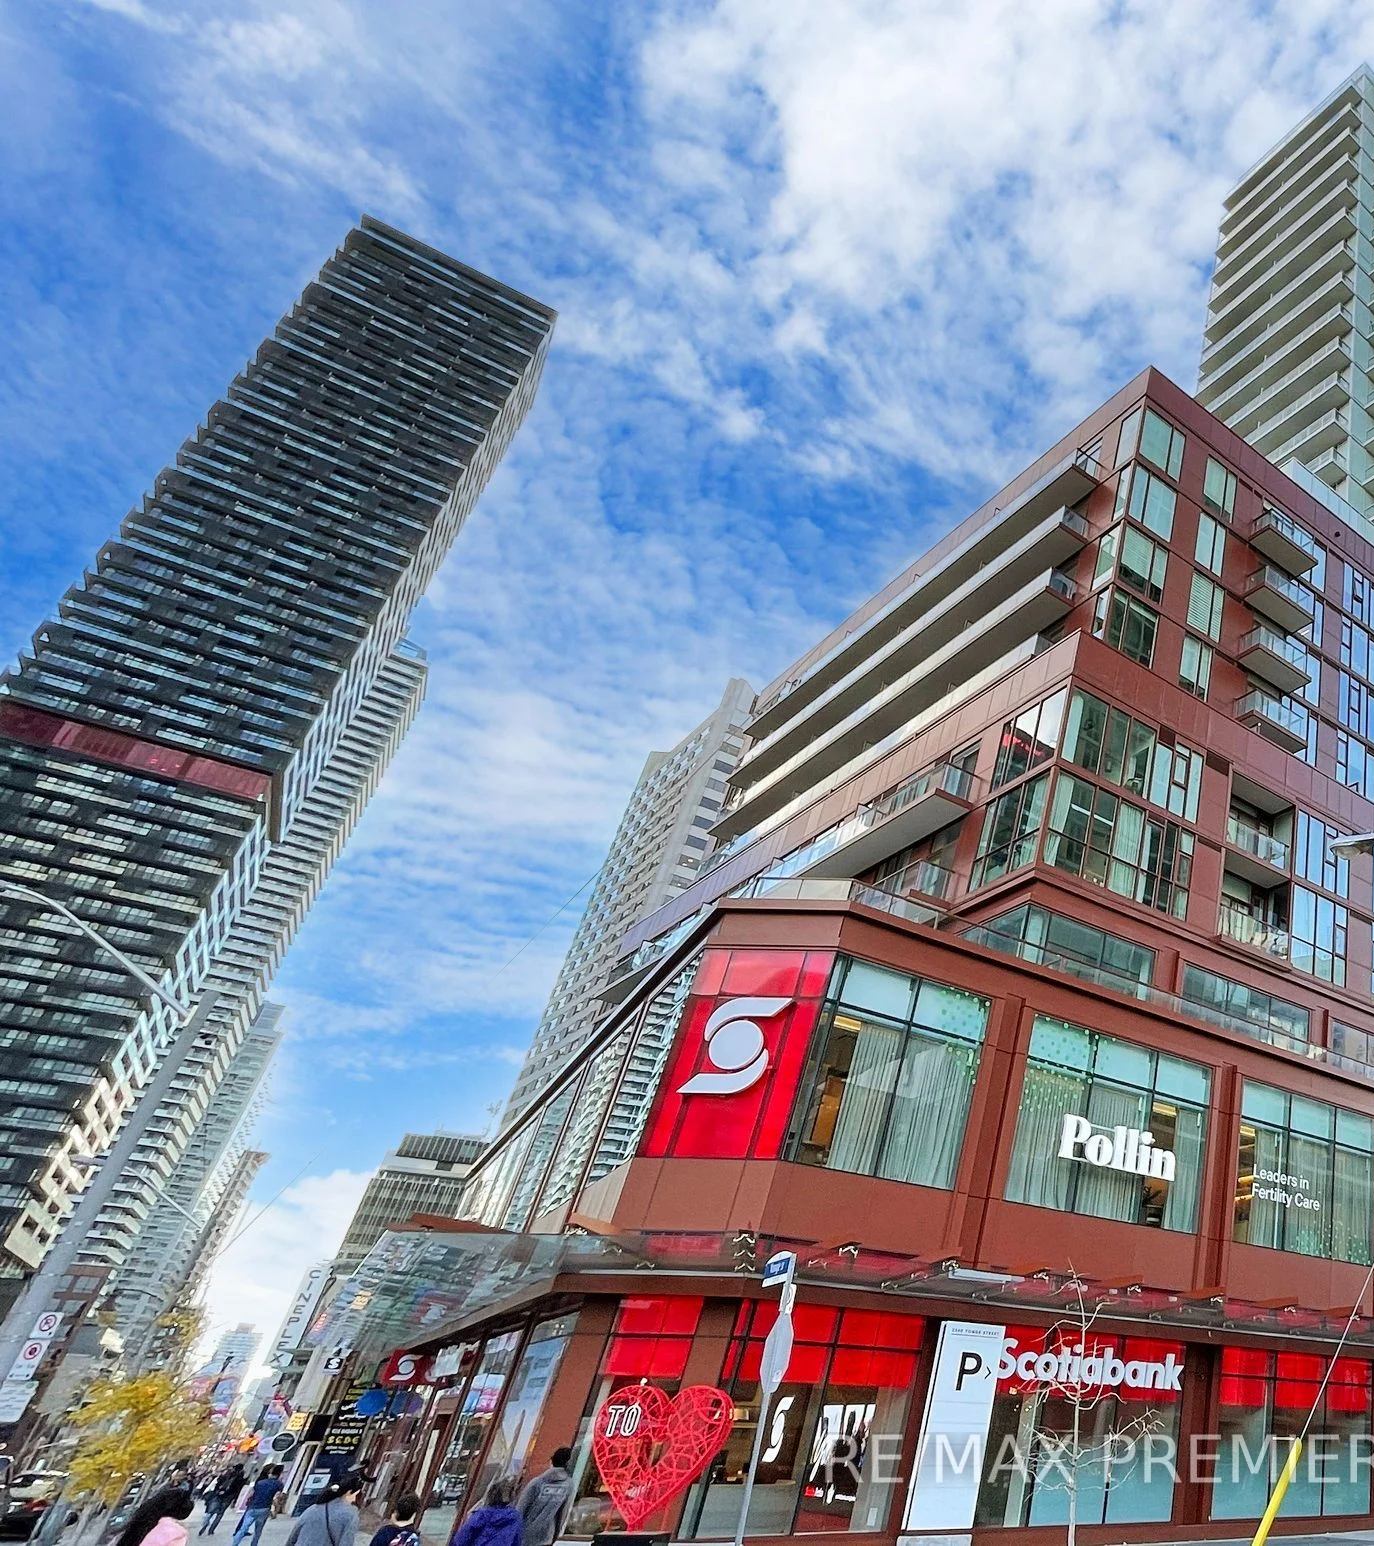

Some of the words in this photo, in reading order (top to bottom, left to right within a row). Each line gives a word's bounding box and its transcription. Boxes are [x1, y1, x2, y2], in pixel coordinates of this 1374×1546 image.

[1058, 1113, 1176, 1181] Pollin
[1251, 1182, 1293, 1208] Fertility
[1294, 1192, 1320, 1211] Care
[1252, 1163, 1298, 1187] Leaders
[1299, 1174, 1310, 1190] in
[269, 1269, 322, 1364] CINEPLEX
[956, 1351, 983, 1391] P
[998, 1337, 1184, 1391] Scotiabank
[605, 1404, 641, 1437] TO
